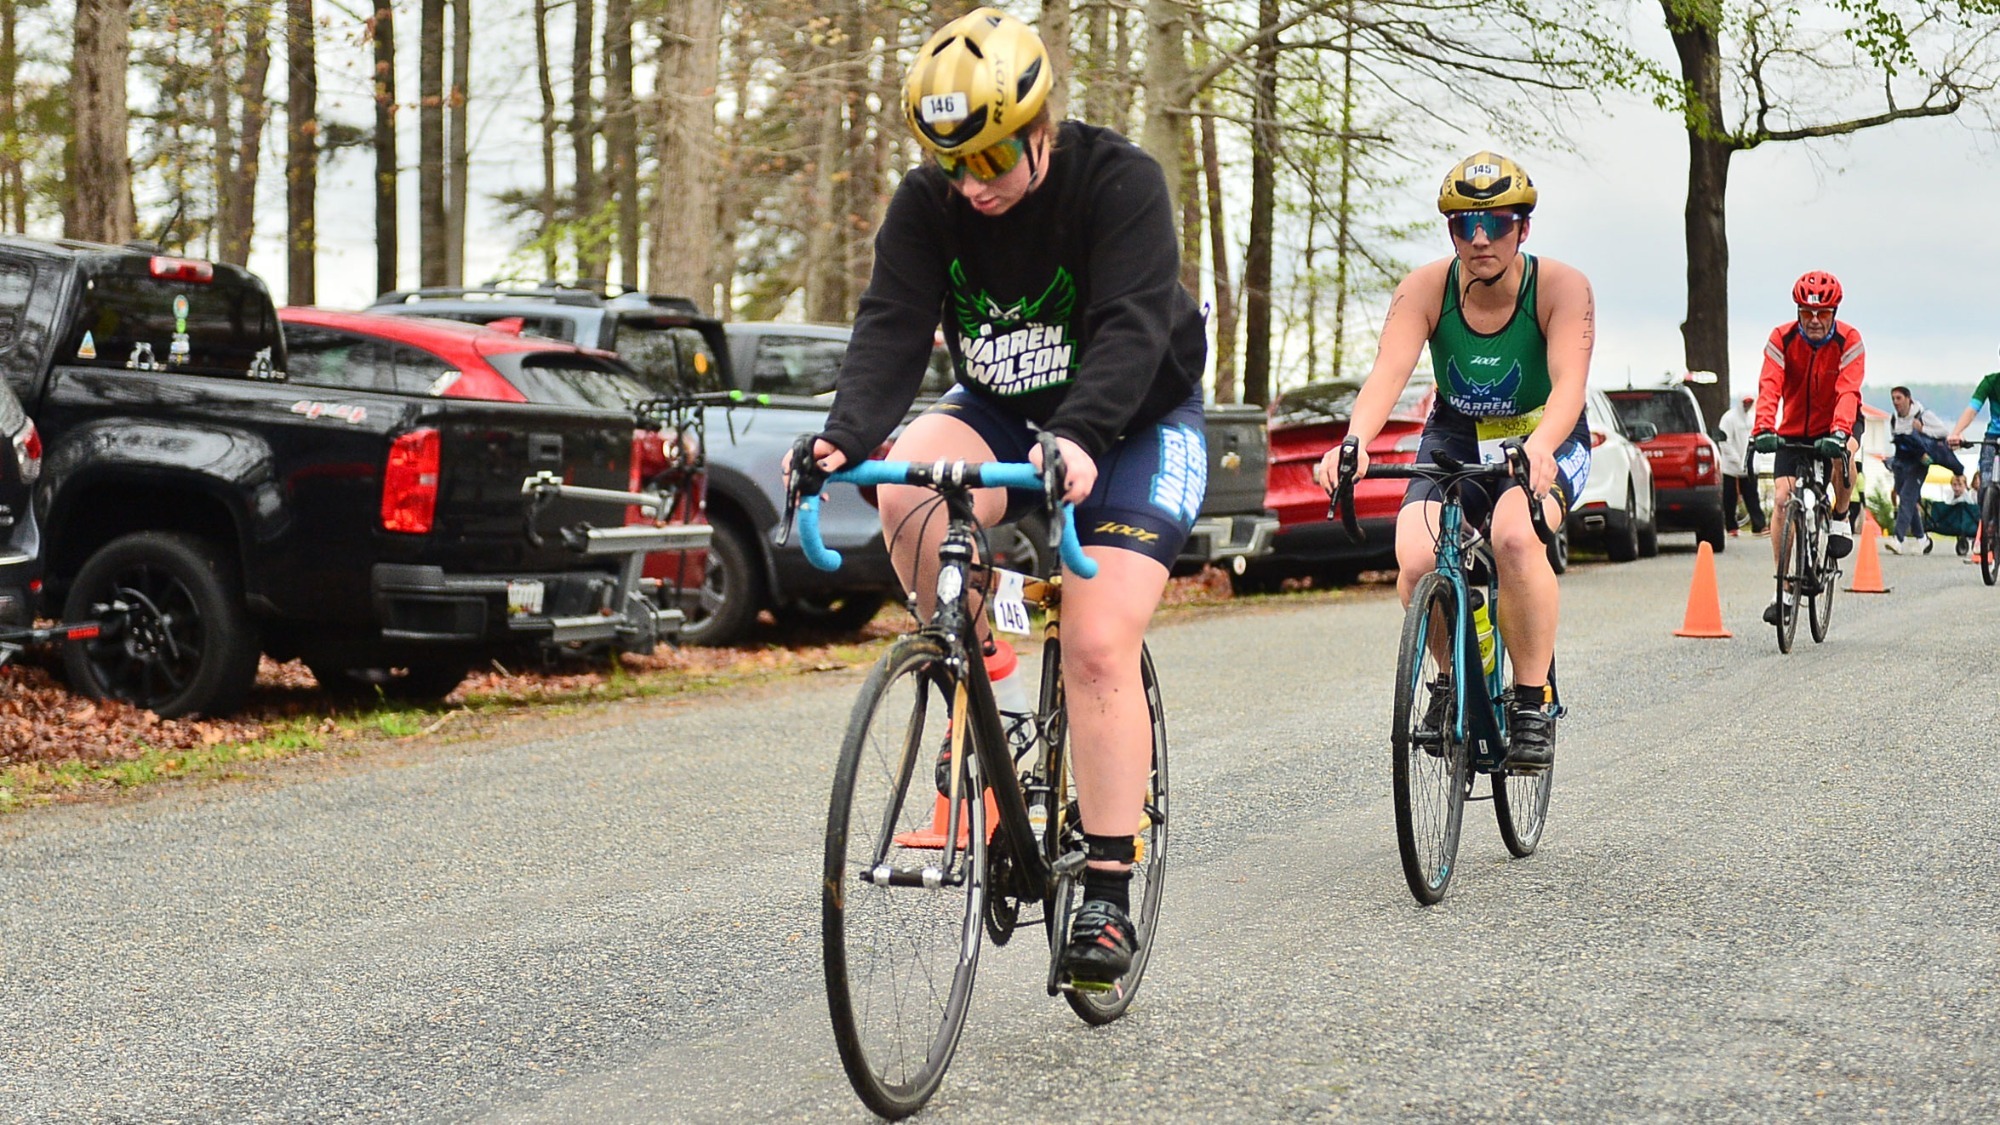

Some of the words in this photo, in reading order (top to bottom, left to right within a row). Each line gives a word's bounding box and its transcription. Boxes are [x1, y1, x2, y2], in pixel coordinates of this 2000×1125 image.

[989, 53, 1007, 125] RUDY
[930, 96, 955, 114] 146
[1473, 164, 1492, 174] 145
[1471, 199, 1496, 207] RUDY
[1579, 287, 1593, 351] 145
[958, 325, 1064, 365] WARREN
[966, 344, 1072, 385] WILSON
[990, 368, 1068, 395] TRIATHLON
[1449, 396, 1512, 410] WARREN
[1457, 408, 1516, 417] WILSON
[1502, 420, 1528, 432] 2025
[1155, 428, 1184, 515] WARREN
[1183, 427, 1203, 518] WILSON
[999, 601, 1024, 630] 146
